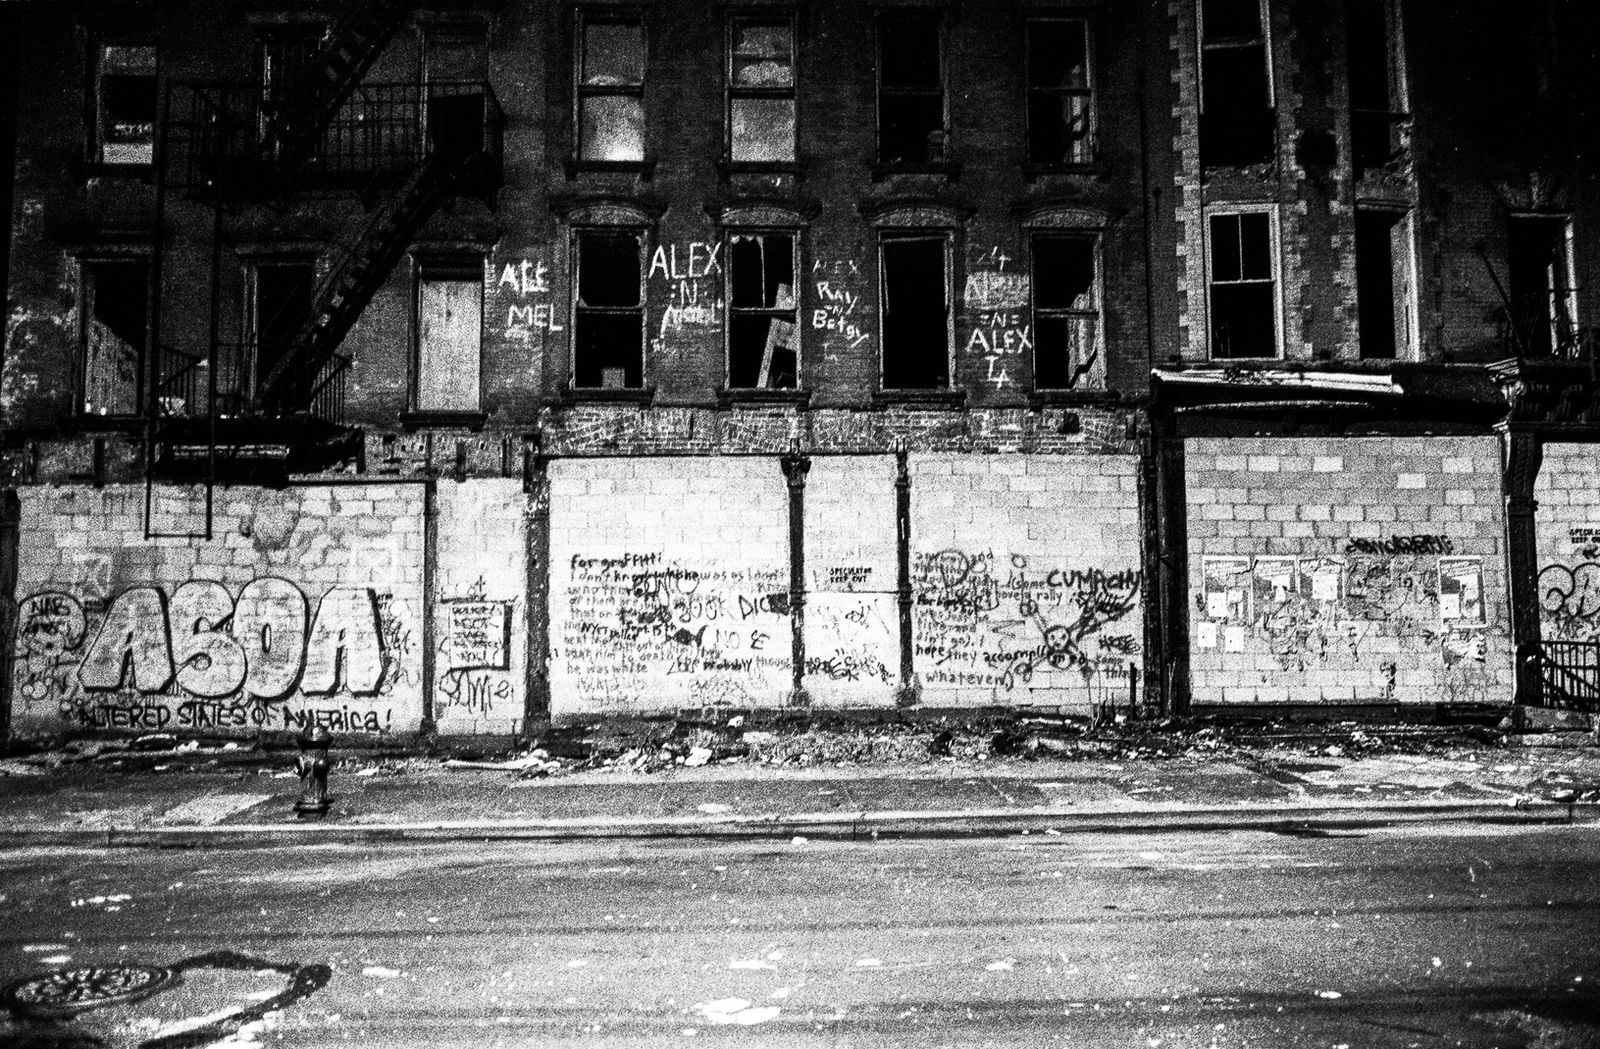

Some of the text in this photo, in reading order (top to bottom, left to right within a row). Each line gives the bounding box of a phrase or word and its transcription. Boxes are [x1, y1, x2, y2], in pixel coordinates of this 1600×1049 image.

[648, 241, 722, 280] ALEX
[507, 303, 563, 331] MEL
[965, 325, 1031, 353] ALEX
[915, 643, 946, 658] hope
[176, 700, 246, 729] STATES
